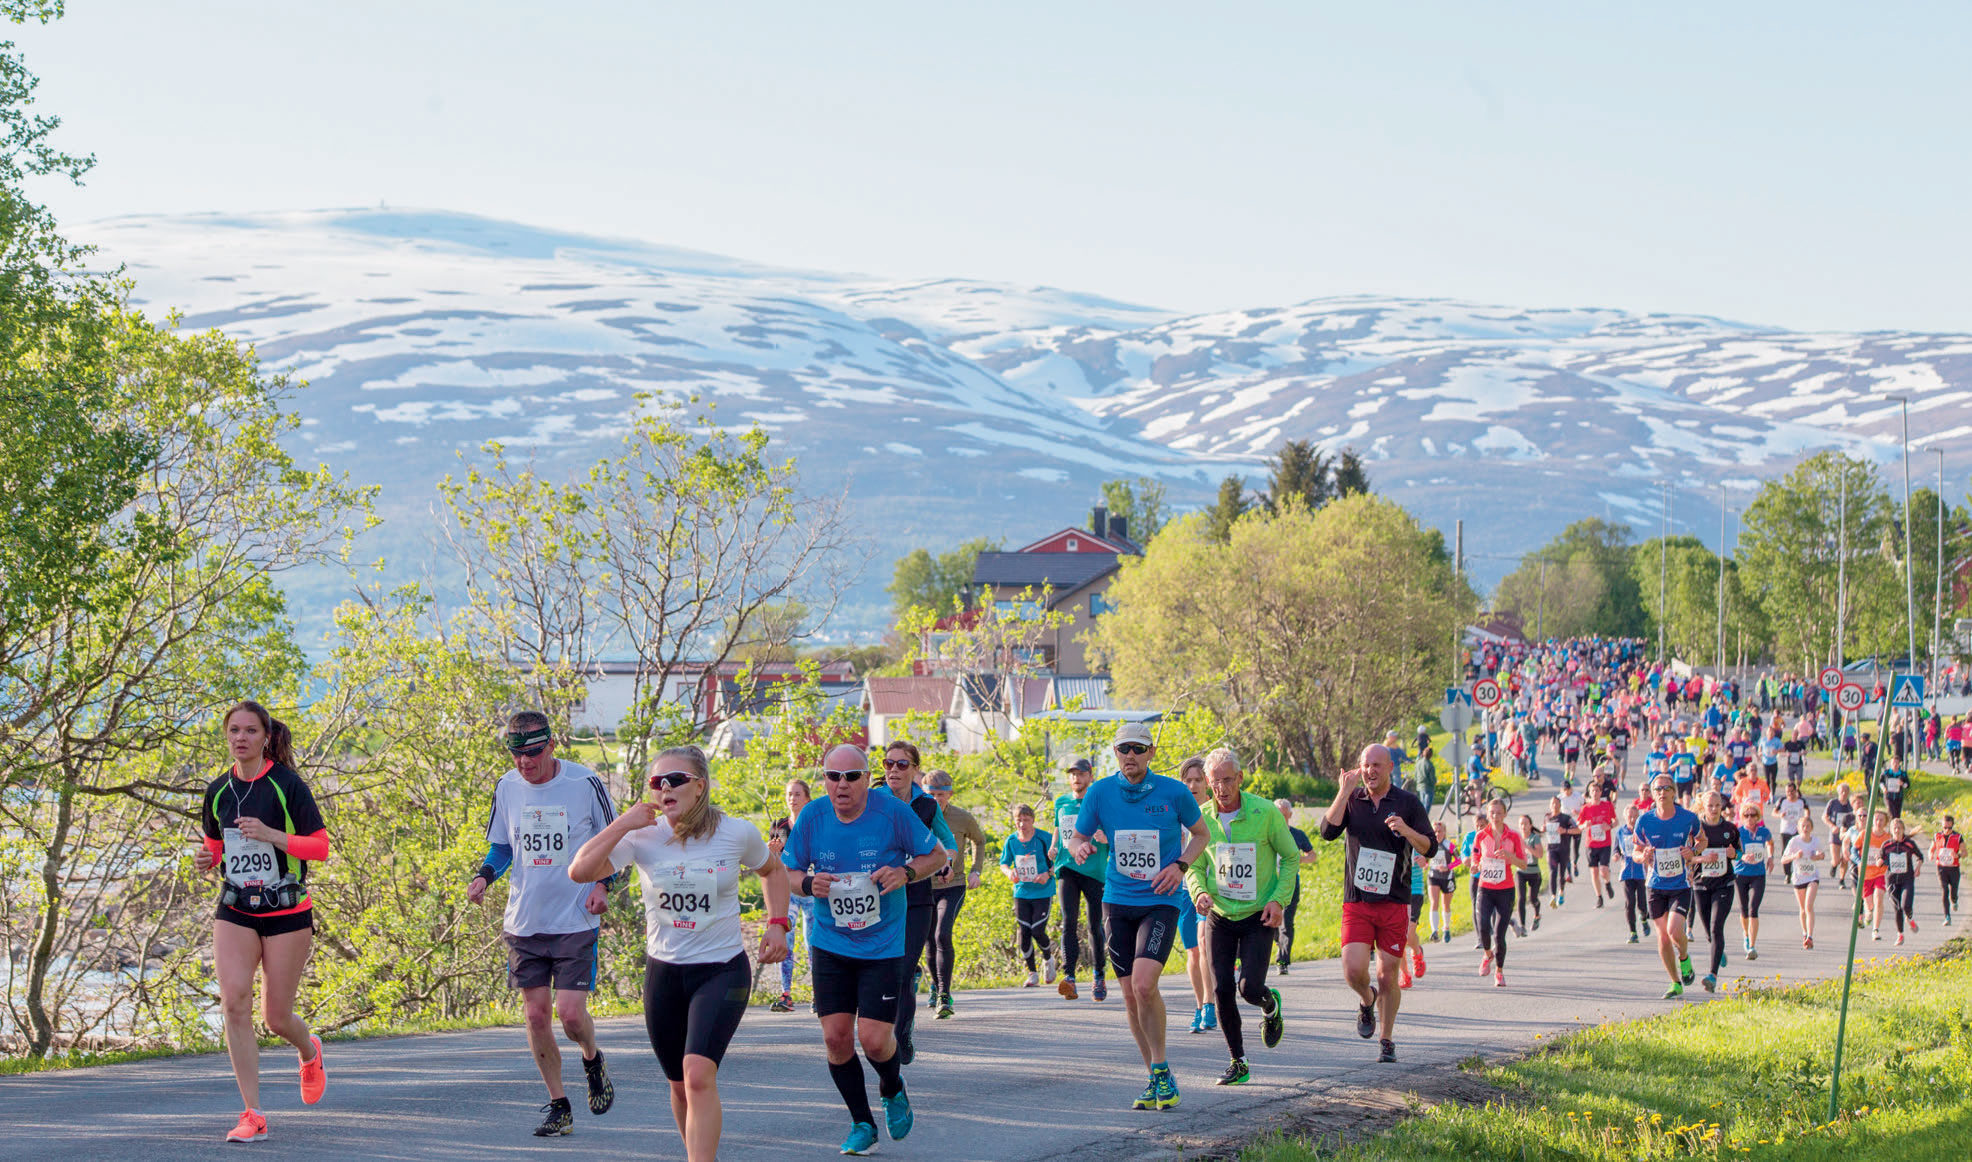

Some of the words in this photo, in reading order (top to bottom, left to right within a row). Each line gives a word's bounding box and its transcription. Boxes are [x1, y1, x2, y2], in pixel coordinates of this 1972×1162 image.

[1824, 674, 1839, 685] 30
[1479, 687, 1496, 700] 30
[1842, 690, 1860, 704] 30
[1063, 829, 1073, 840] 32
[523, 833, 563, 852] 3518
[820, 850, 835, 860] DNB
[1119, 852, 1156, 868] 3256
[230, 853, 272, 874] 2299
[1659, 860, 1680, 871] 3298
[1704, 860, 1724, 869] 2201
[1219, 864, 1252, 878] 4102
[1357, 867, 1389, 884] 3013
[1483, 869, 1503, 878] 2027
[659, 892, 710, 913] 2034
[833, 895, 876, 915] 3952
[676, 921, 694, 929] TINE
[1148, 920, 1165, 955] 2XU
